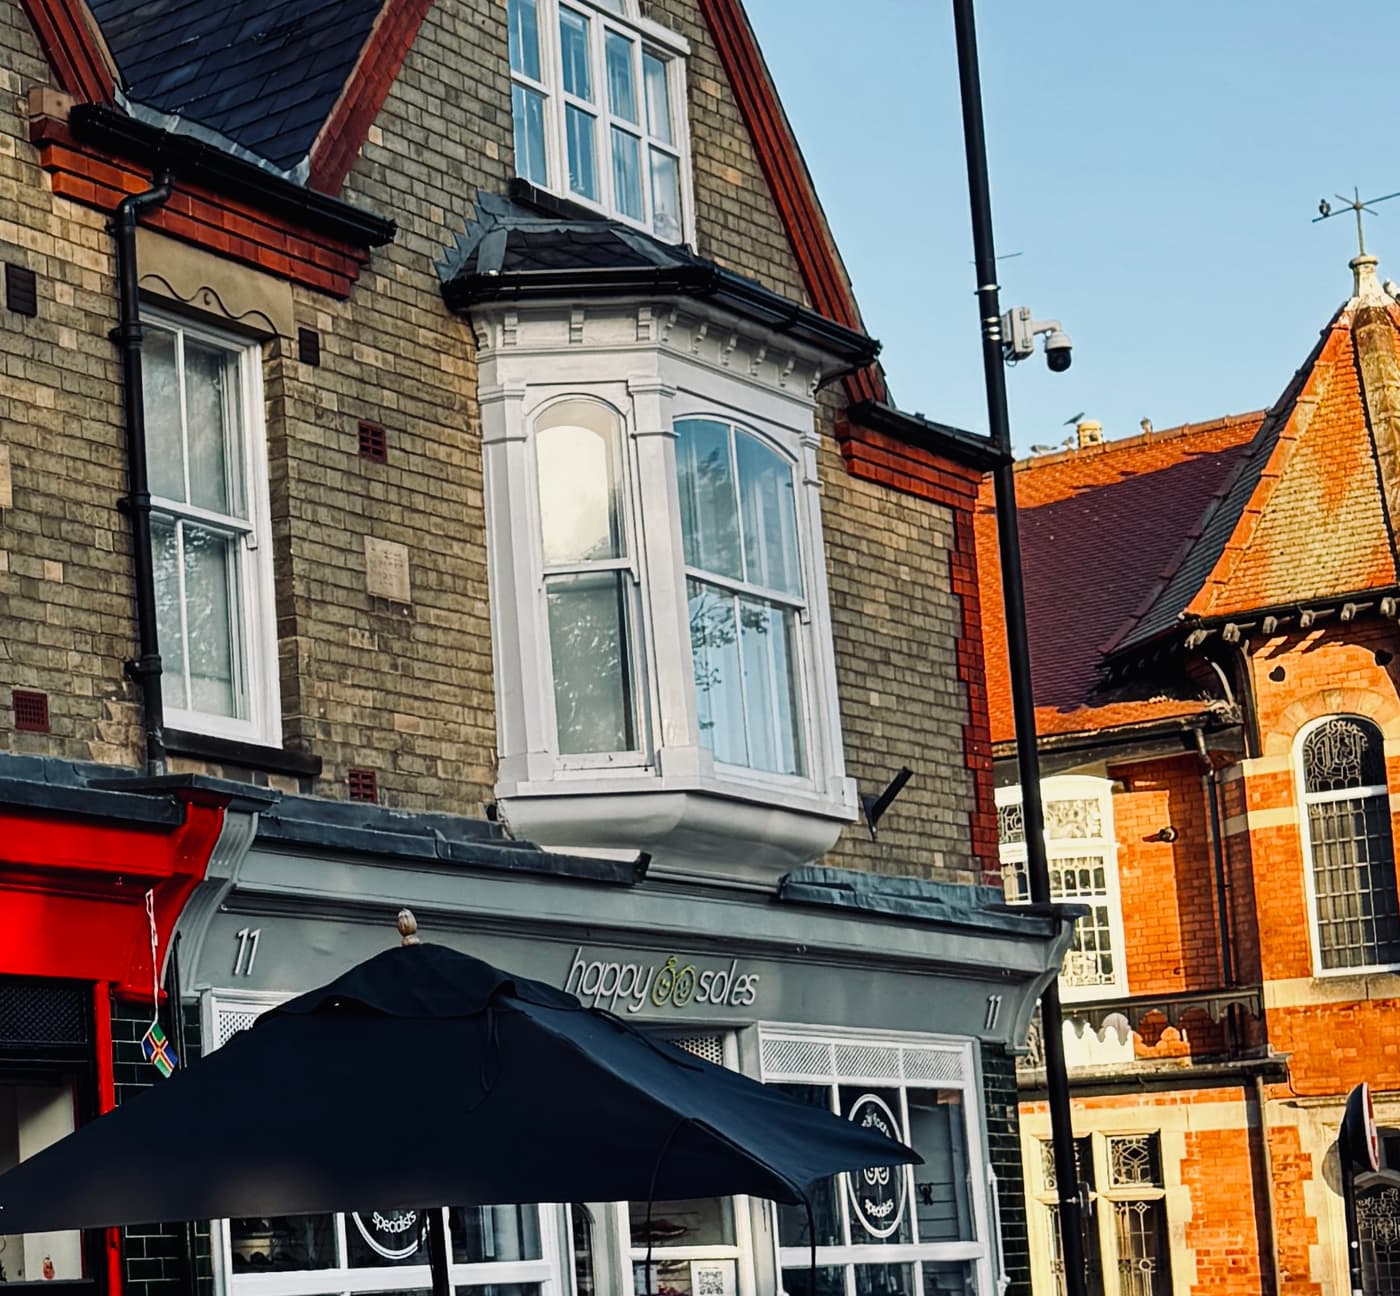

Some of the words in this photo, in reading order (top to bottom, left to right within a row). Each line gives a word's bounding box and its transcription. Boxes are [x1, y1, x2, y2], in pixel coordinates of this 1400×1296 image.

[234, 927, 261, 976] 11
[565, 945, 653, 1013] happy
[695, 959, 760, 1006] soles
[986, 994, 1002, 1030] 11
